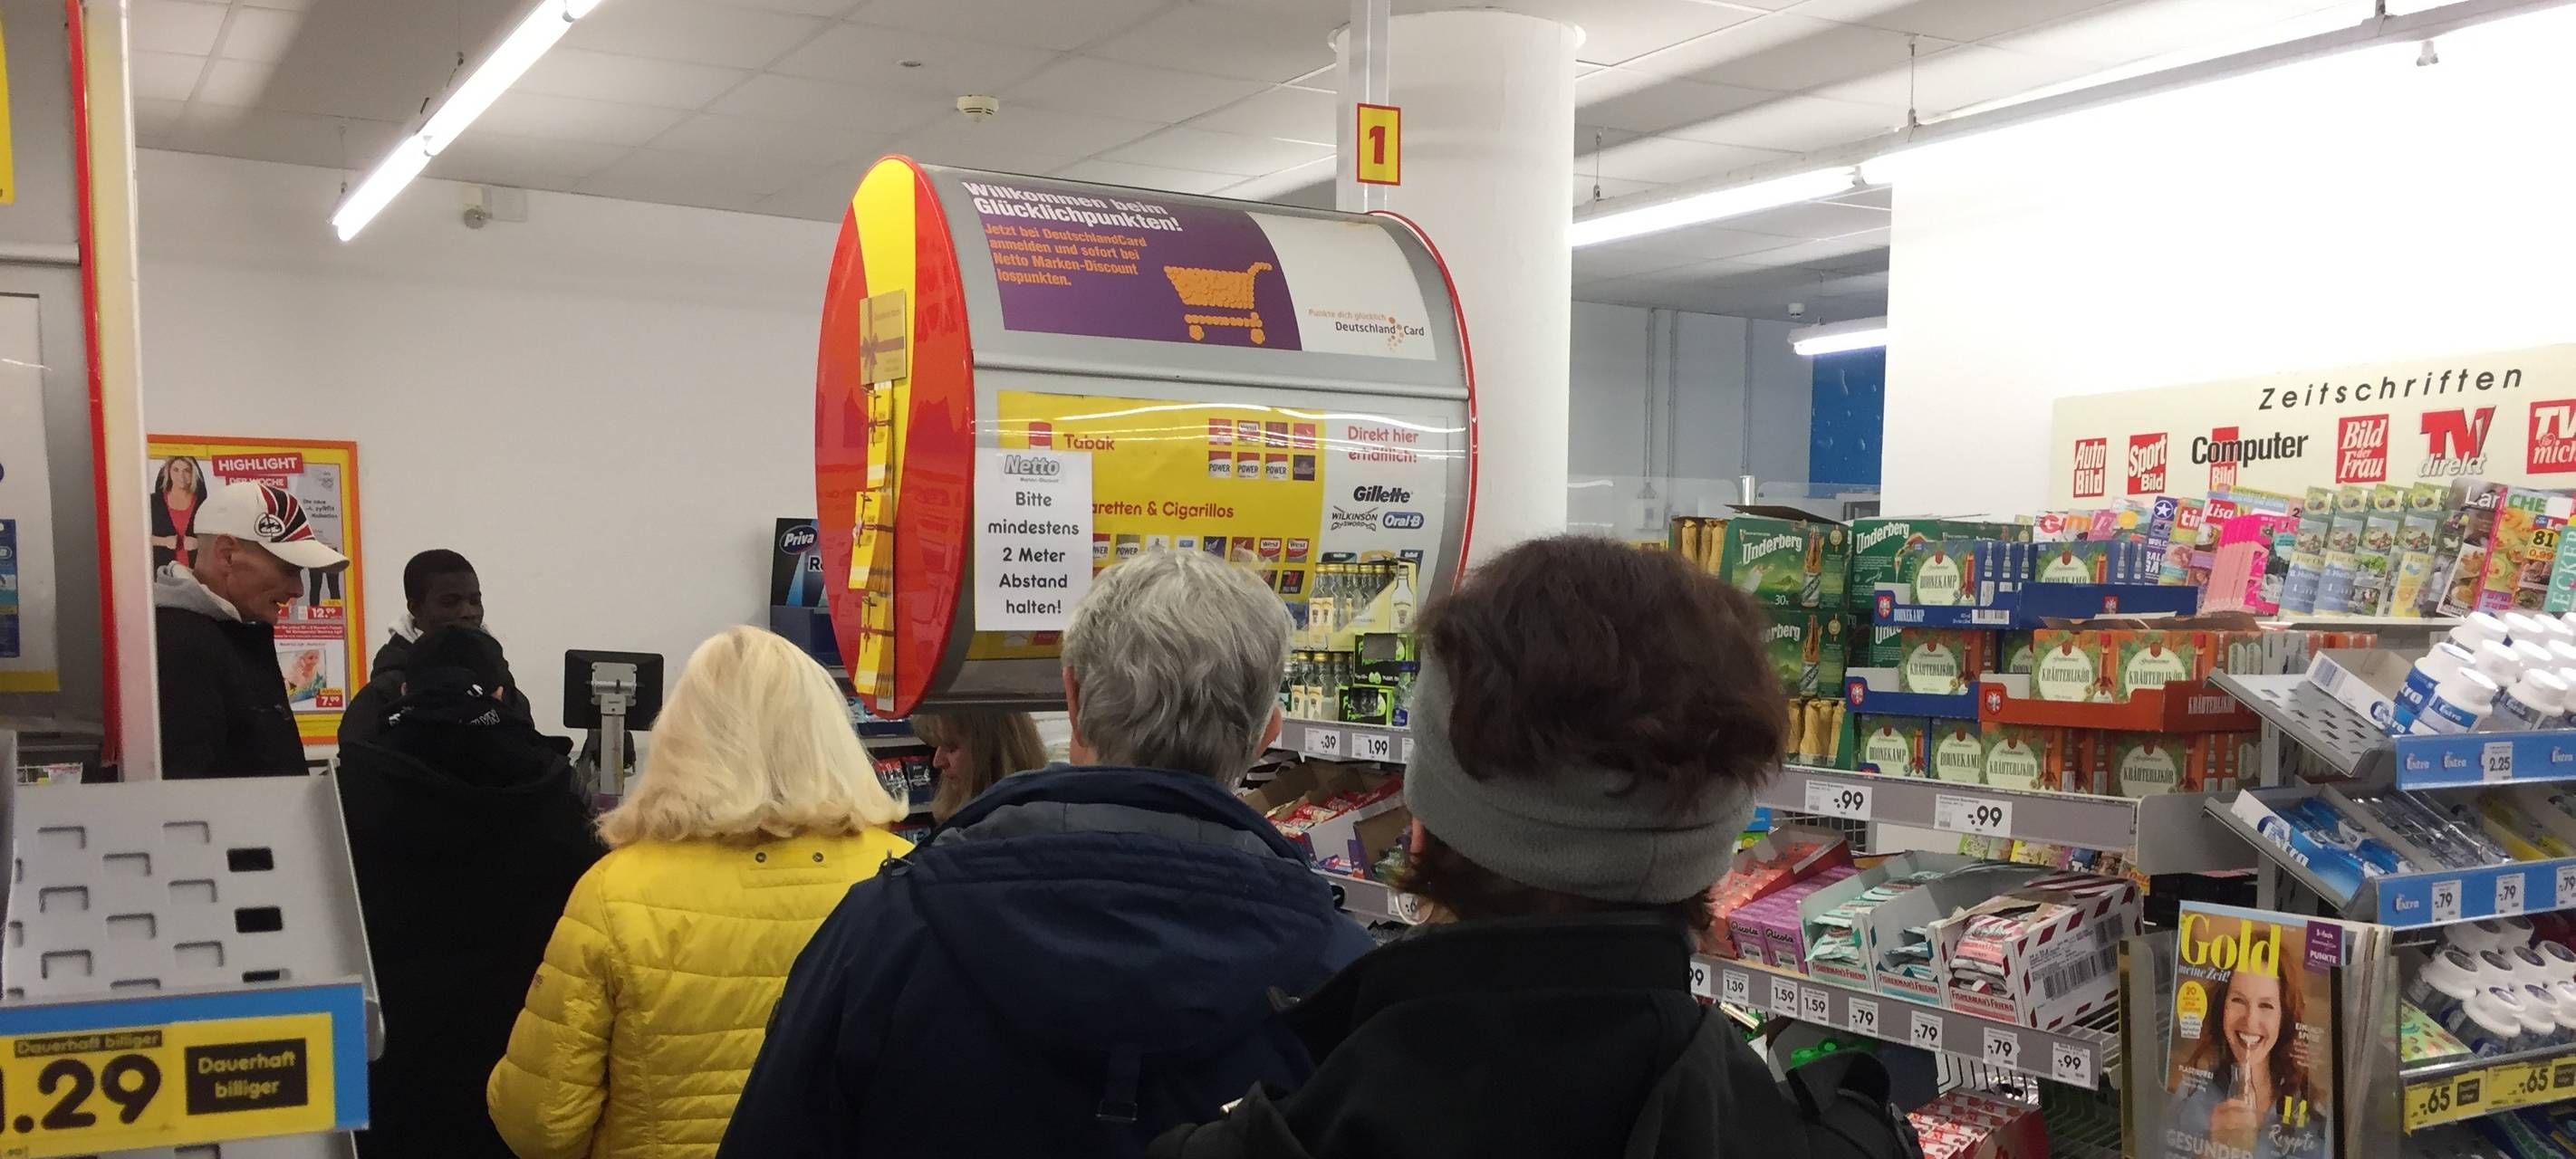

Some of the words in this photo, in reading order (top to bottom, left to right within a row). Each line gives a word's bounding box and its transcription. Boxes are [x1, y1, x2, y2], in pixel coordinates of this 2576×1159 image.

[1370, 126, 1385, 164] 1
[962, 182, 1107, 208] Willkommen
[1110, 198, 1168, 216] beim
[973, 196, 1183, 232] Glücklichpunkten!
[985, 224, 1016, 235] Jetzt
[1020, 227, 1039, 238] bei
[1043, 228, 1147, 247] DeutschlandCard
[990, 238, 1051, 254] anmelden
[1055, 244, 1078, 255] und
[1081, 246, 1117, 258] sofort
[1120, 248, 1140, 260] bei
[994, 253, 1028, 266] Netto
[1033, 254, 1139, 275] Marken-Discount
[997, 268, 1072, 286] lospunkten.
[1308, 309, 1336, 318] Punkte
[1337, 311, 1352, 319] dich
[1354, 311, 1387, 321] glücklich
[1335, 321, 1396, 334] Deutschland
[1404, 325, 1425, 336] Card
[2258, 368, 2523, 410] Zeitschriften
[1063, 433, 1115, 451] Tabak
[1348, 426, 1389, 443] Direkt
[1393, 429, 1419, 444] hier
[2341, 419, 2387, 450] Bild
[2419, 406, 2496, 460] TV
[2074, 441, 2106, 470] Auto
[2129, 435, 2167, 478] Sport
[2192, 432, 2309, 468] Computer
[2357, 448, 2371, 458] der
[217, 456, 298, 472] HIGHLIGHT
[1004, 455, 1061, 476] Netto
[1209, 463, 1231, 473] POWER
[1237, 465, 1259, 474] POWER
[1265, 465, 1287, 474] POWER
[2340, 451, 2384, 479] Frau
[2417, 452, 2487, 478] direkt
[2075, 469, 2103, 494] Bild
[2141, 473, 2164, 492] Bild
[2212, 465, 2235, 485] Bild
[1015, 492, 1053, 507] Bitte
[1353, 485, 1411, 503] Gillette
[1147, 501, 1158, 516] &
[1162, 502, 1235, 520] Cigarillos
[1331, 512, 1379, 522] WILKINSON
[2206, 502, 2235, 520] Lisa
[987, 519, 1080, 535] mindestens
[1384, 514, 1422, 528] Oral-B
[783, 531, 815, 548] Priva
[1856, 522, 1910, 554] Underberg
[2533, 530, 2553, 548] 81
[1003, 547, 1013, 562] 2
[1018, 547, 1066, 562] Meter
[1116, 547, 1139, 556] POWER
[1741, 534, 1802, 566] Underberg
[2529, 549, 2554, 560] 0.99
[998, 573, 1068, 589] Abstand
[312, 608, 336, 618] 12.99
[1005, 599, 1062, 615] halten!
[1909, 659, 1955, 676] KRÄUTERLIKÖR
[2042, 667, 2090, 684] KRÄUTERLIKÖR
[321, 696, 341, 706] 7.99
[2187, 695, 2236, 714] KRÄUTERLIKÖR
[1368, 739, 1388, 755] 1.99
[1989, 760, 2034, 777] KRÄUTERLIKÖR
[2489, 756, 2511, 771] 2.25
[2122, 766, 2174, 784] KRÄUTERLIKÖR
[1833, 790, 1864, 811] -.99
[1967, 805, 2003, 828] -.99
[1731, 921, 1759, 936] Ricola
[1765, 928, 1795, 943] Ricola
[2179, 913, 2282, 979] Gold
[2310, 950, 2337, 964] PUNKTE
[1725, 980, 1745, 993] 1.39
[1774, 987, 1795, 1003] 1.59
[1804, 997, 1826, 1013] 1.59
[18, 1036, 100, 1056] Dauerhaft
[104, 1032, 159, 1049] billiger
[197, 1049, 295, 1075] Dauerhaft
[0, 1053, 163, 1134] .29
[215, 1081, 279, 1100] billiger
